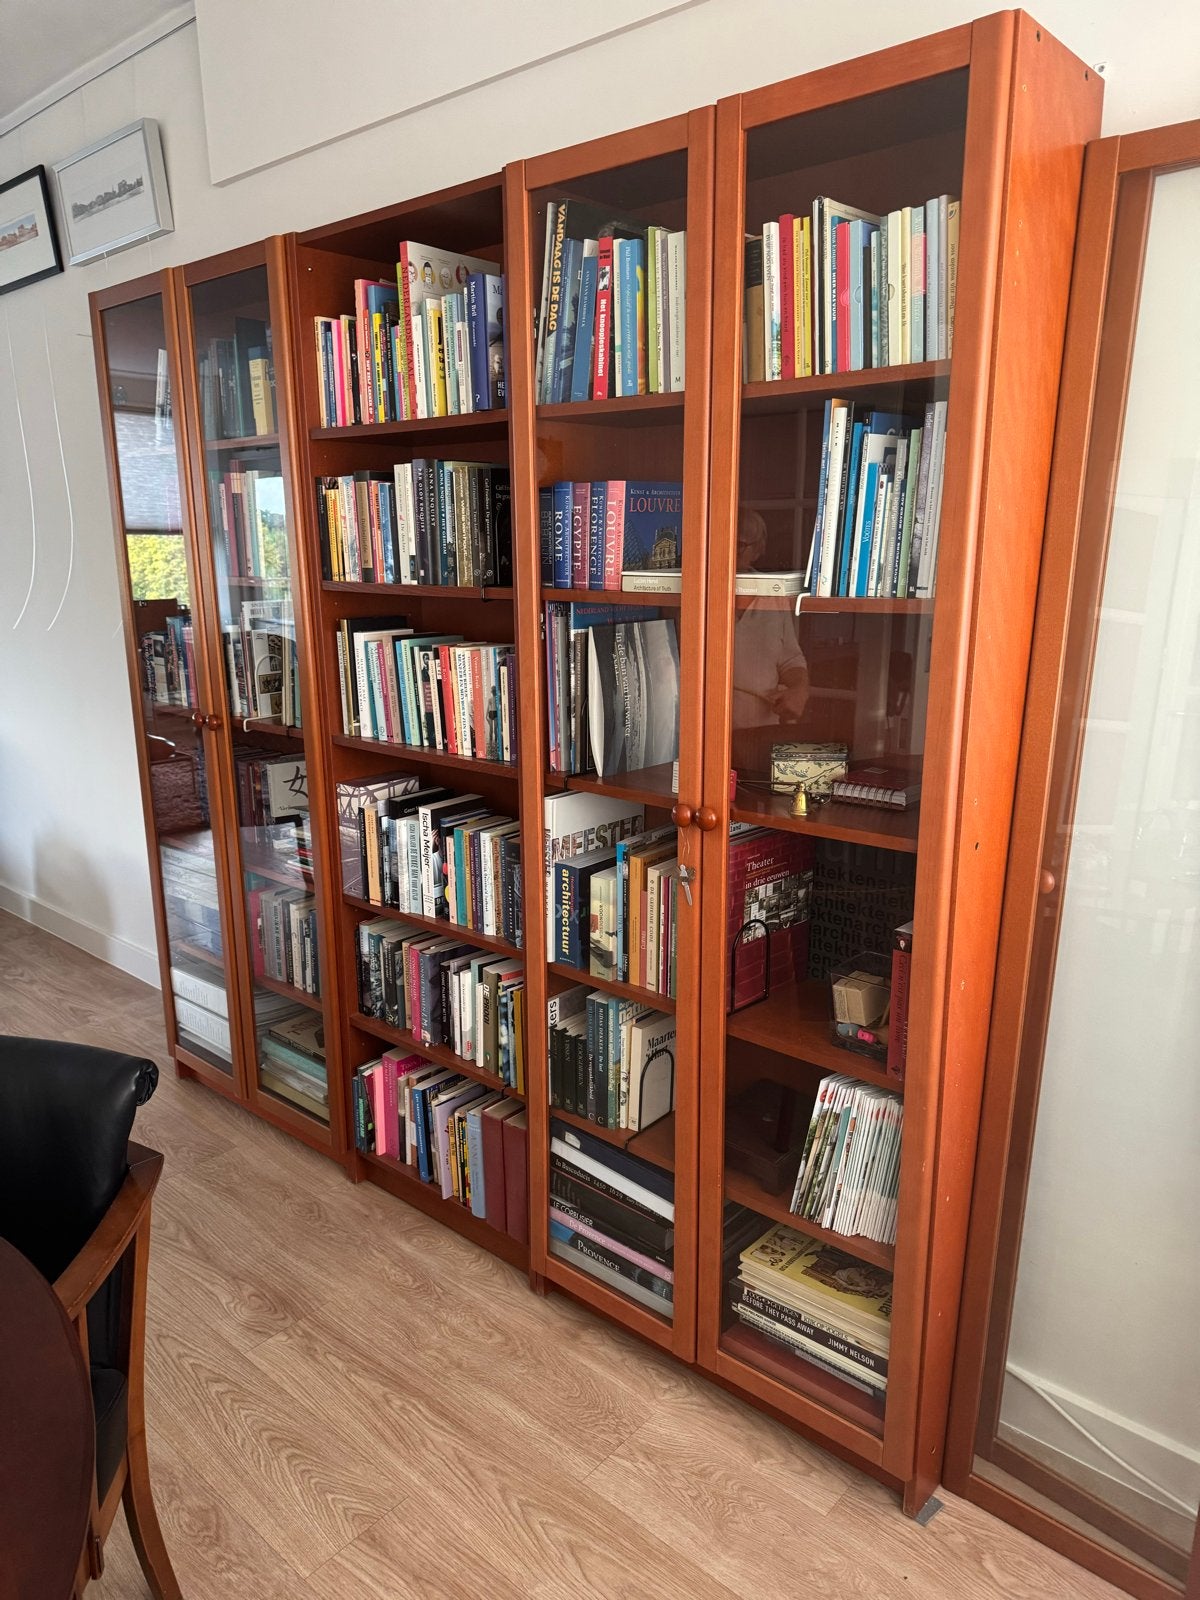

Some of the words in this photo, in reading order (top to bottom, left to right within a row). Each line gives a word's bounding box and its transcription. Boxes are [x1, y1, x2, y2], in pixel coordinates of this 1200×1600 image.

[553, 203, 566, 269] VANDAAG
[553, 271, 560, 284] IS
[401, 266, 413, 348] NEDERLANDSE
[551, 285, 560, 306] DE
[549, 305, 559, 332] DAG
[598, 313, 606, 377] knoopjeskabinet
[406, 348, 414, 380] TAAL
[629, 497, 681, 513] LOUVRE
[554, 511, 563, 562] ROME
[573, 505, 582, 570] EGYPTE
[590, 496, 598, 575] FLORENCE
[605, 500, 617, 576] LOUVRE
[615, 632, 623, 642] In
[617, 643, 625, 656] de
[619, 656, 627, 675] ban
[623, 694, 631, 710] het
[421, 812, 430, 837] Ischa
[422, 839, 432, 869] Meijer
[746, 856, 775, 873] Theater
[745, 881, 752, 889] in
[753, 876, 766, 887] drie
[766, 869, 790, 882] eeuwen
[561, 868, 571, 955] architectuur
[483, 984, 490, 998] DE
[598, 1055, 603, 1063] De
[555, 1159, 562, 1167] In
[560, 1204, 594, 1227] CORBUSIER
[569, 1220, 578, 1229] De
[578, 1225, 606, 1245] Provence
[577, 1239, 621, 1272] PROVENCE
[742, 1294, 763, 1310] BEFORE
[765, 1306, 779, 1318] THEY
[780, 1313, 796, 1327] PASS
[797, 1322, 814, 1336] AWAY
[827, 1337, 848, 1354] JIMMY
[849, 1349, 875, 1368] NELSON
